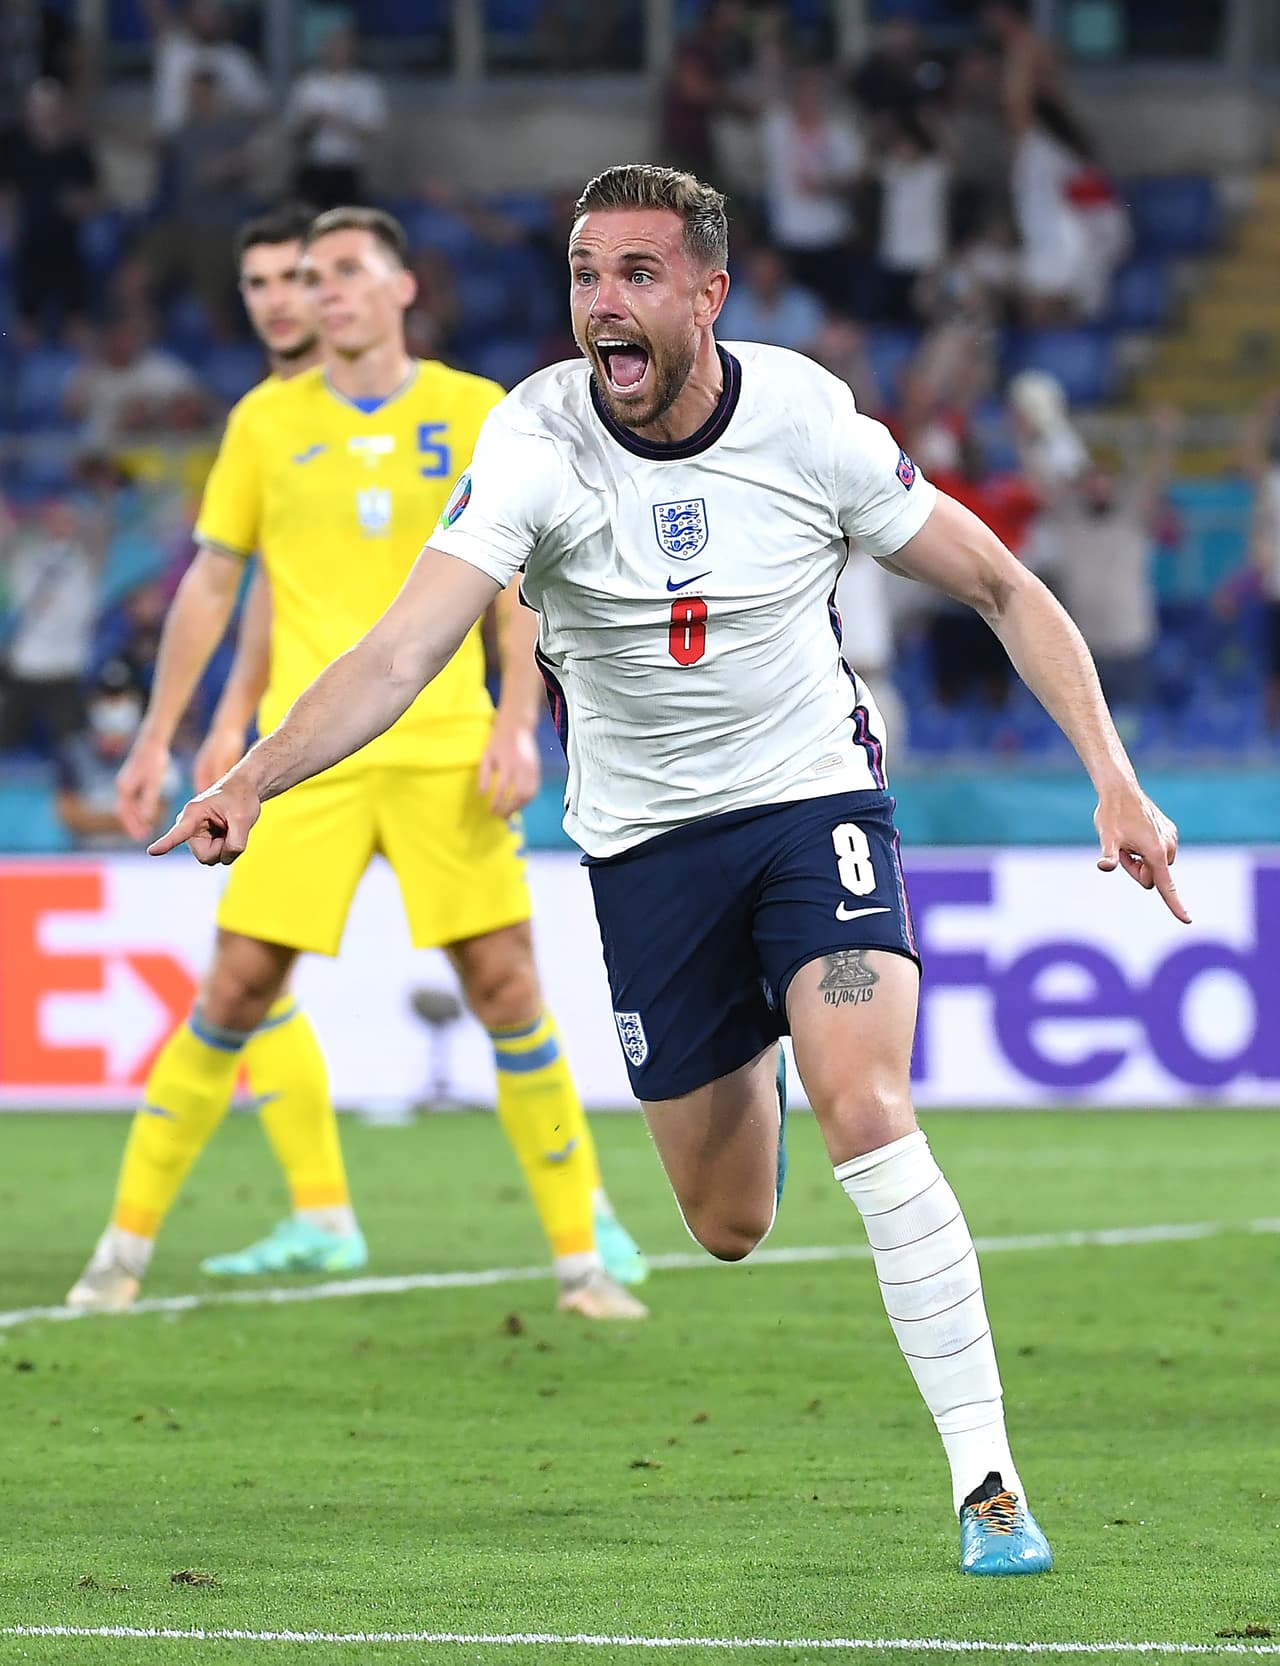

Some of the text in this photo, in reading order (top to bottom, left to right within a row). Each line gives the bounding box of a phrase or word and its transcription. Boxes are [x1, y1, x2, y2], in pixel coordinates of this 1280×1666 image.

[418, 421, 451, 477] 5
[669, 595, 708, 667] 8
[831, 822, 877, 897] 8
[824, 988, 873, 1008] 01/06/19
[903, 866, 1280, 1087] Fed
